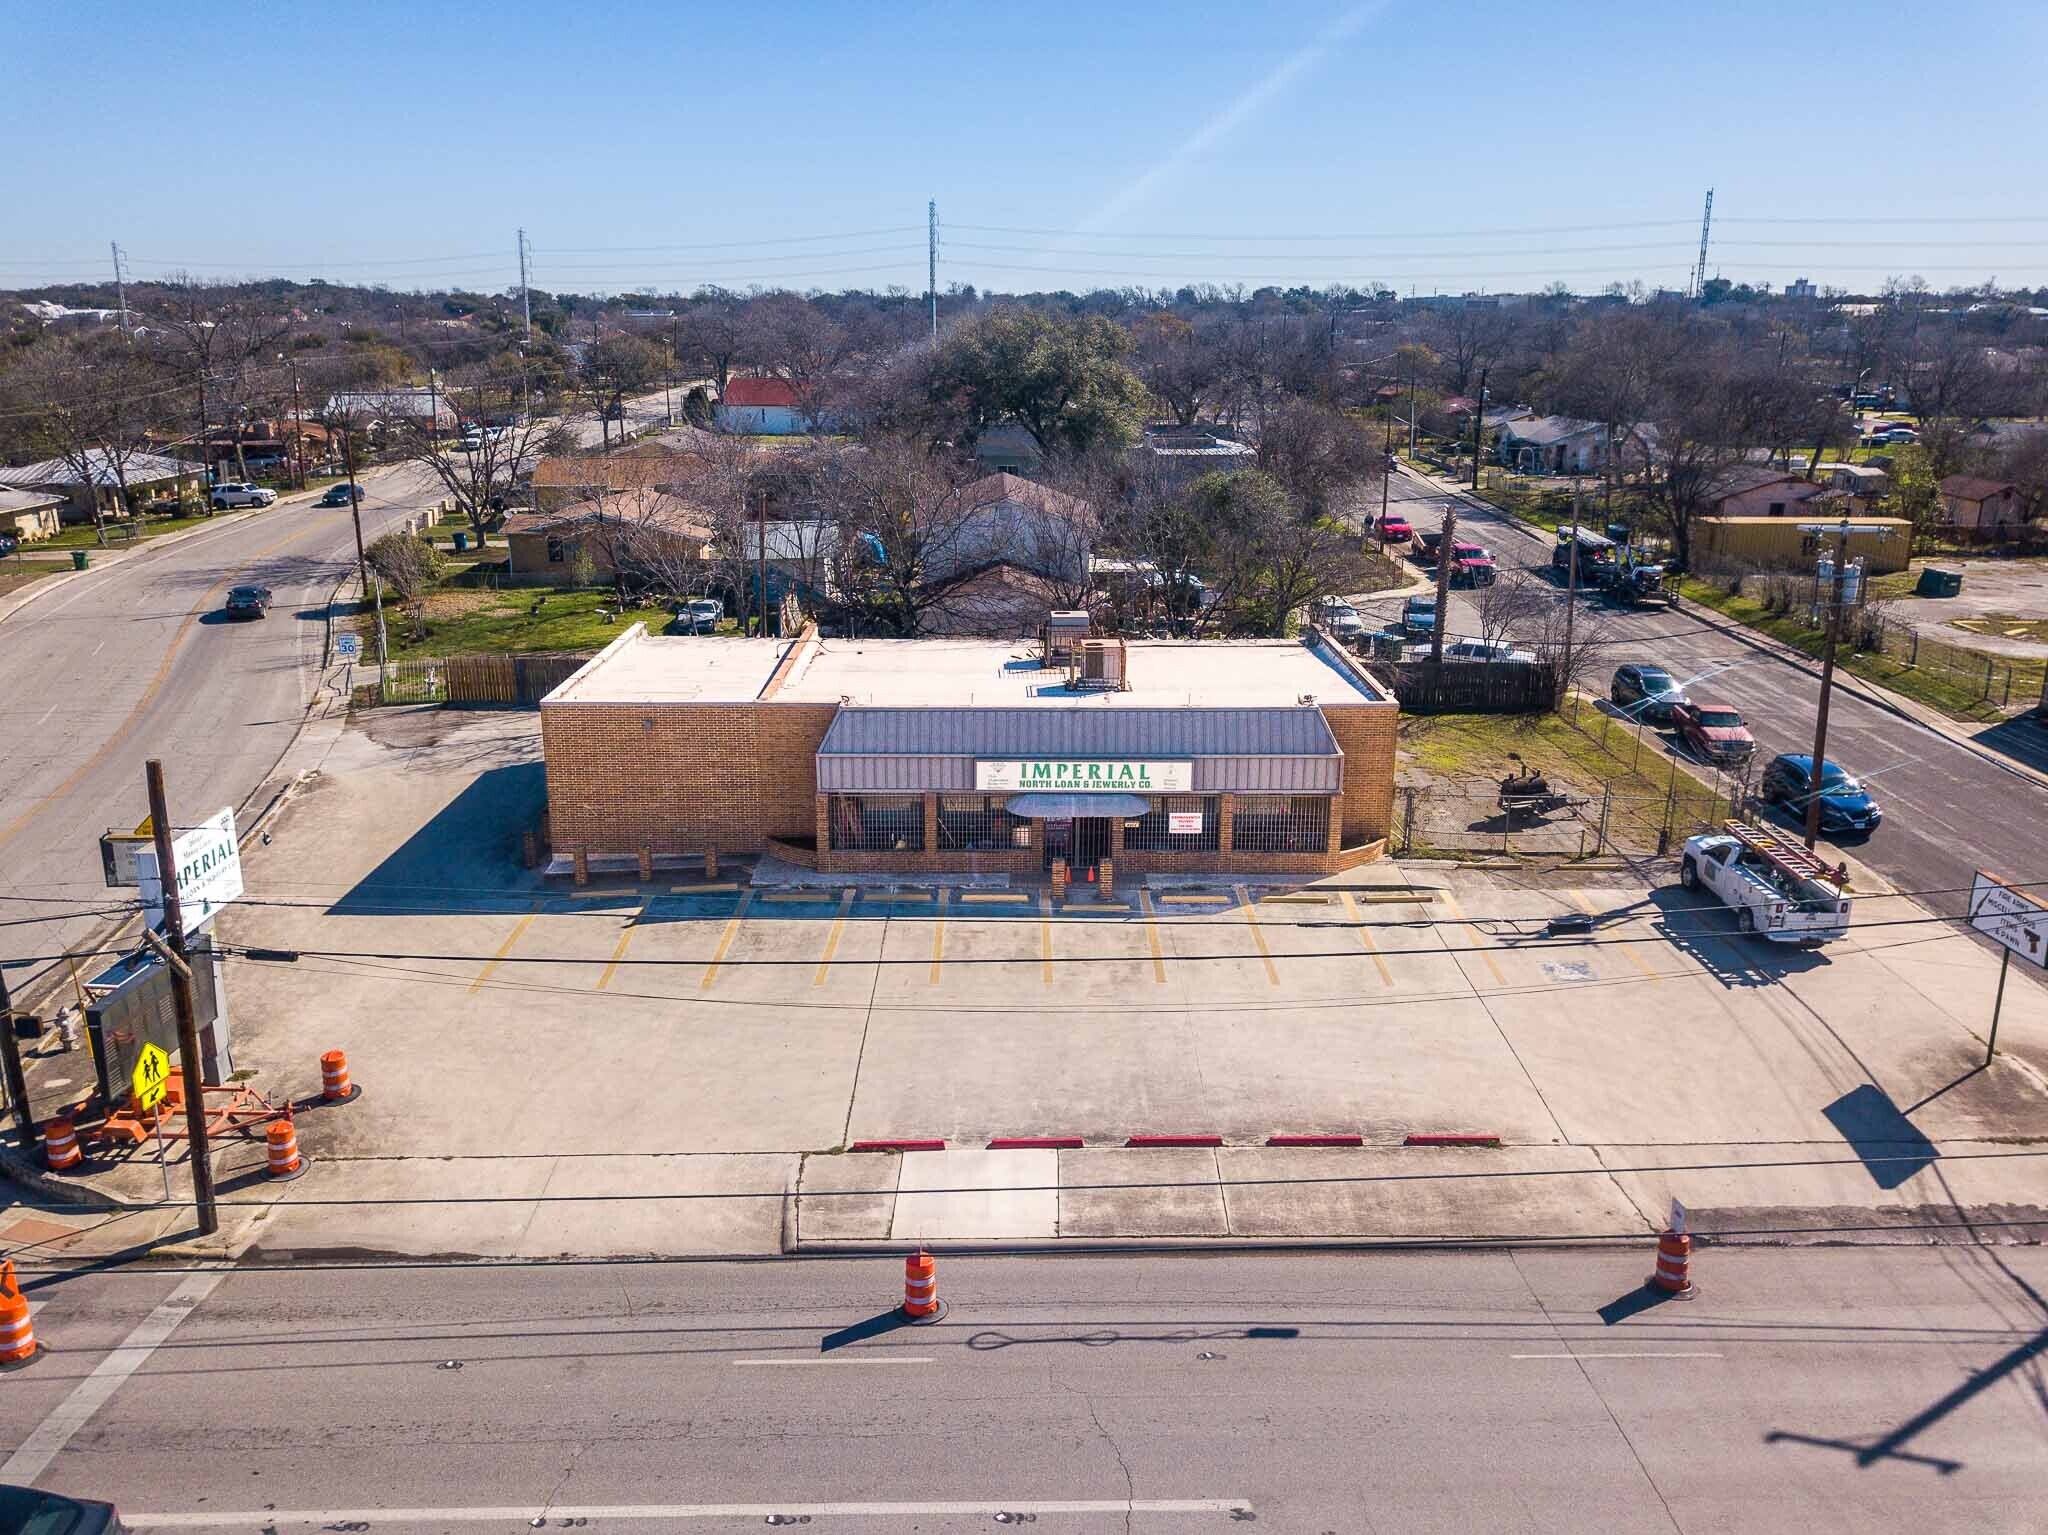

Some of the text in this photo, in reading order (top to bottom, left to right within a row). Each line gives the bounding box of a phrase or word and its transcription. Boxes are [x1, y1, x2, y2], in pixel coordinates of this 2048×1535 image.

[1020, 763, 1150, 779] IMPERIAL
[1019, 780, 1051, 788] NORTH
[1055, 780, 1082, 788] LOAN
